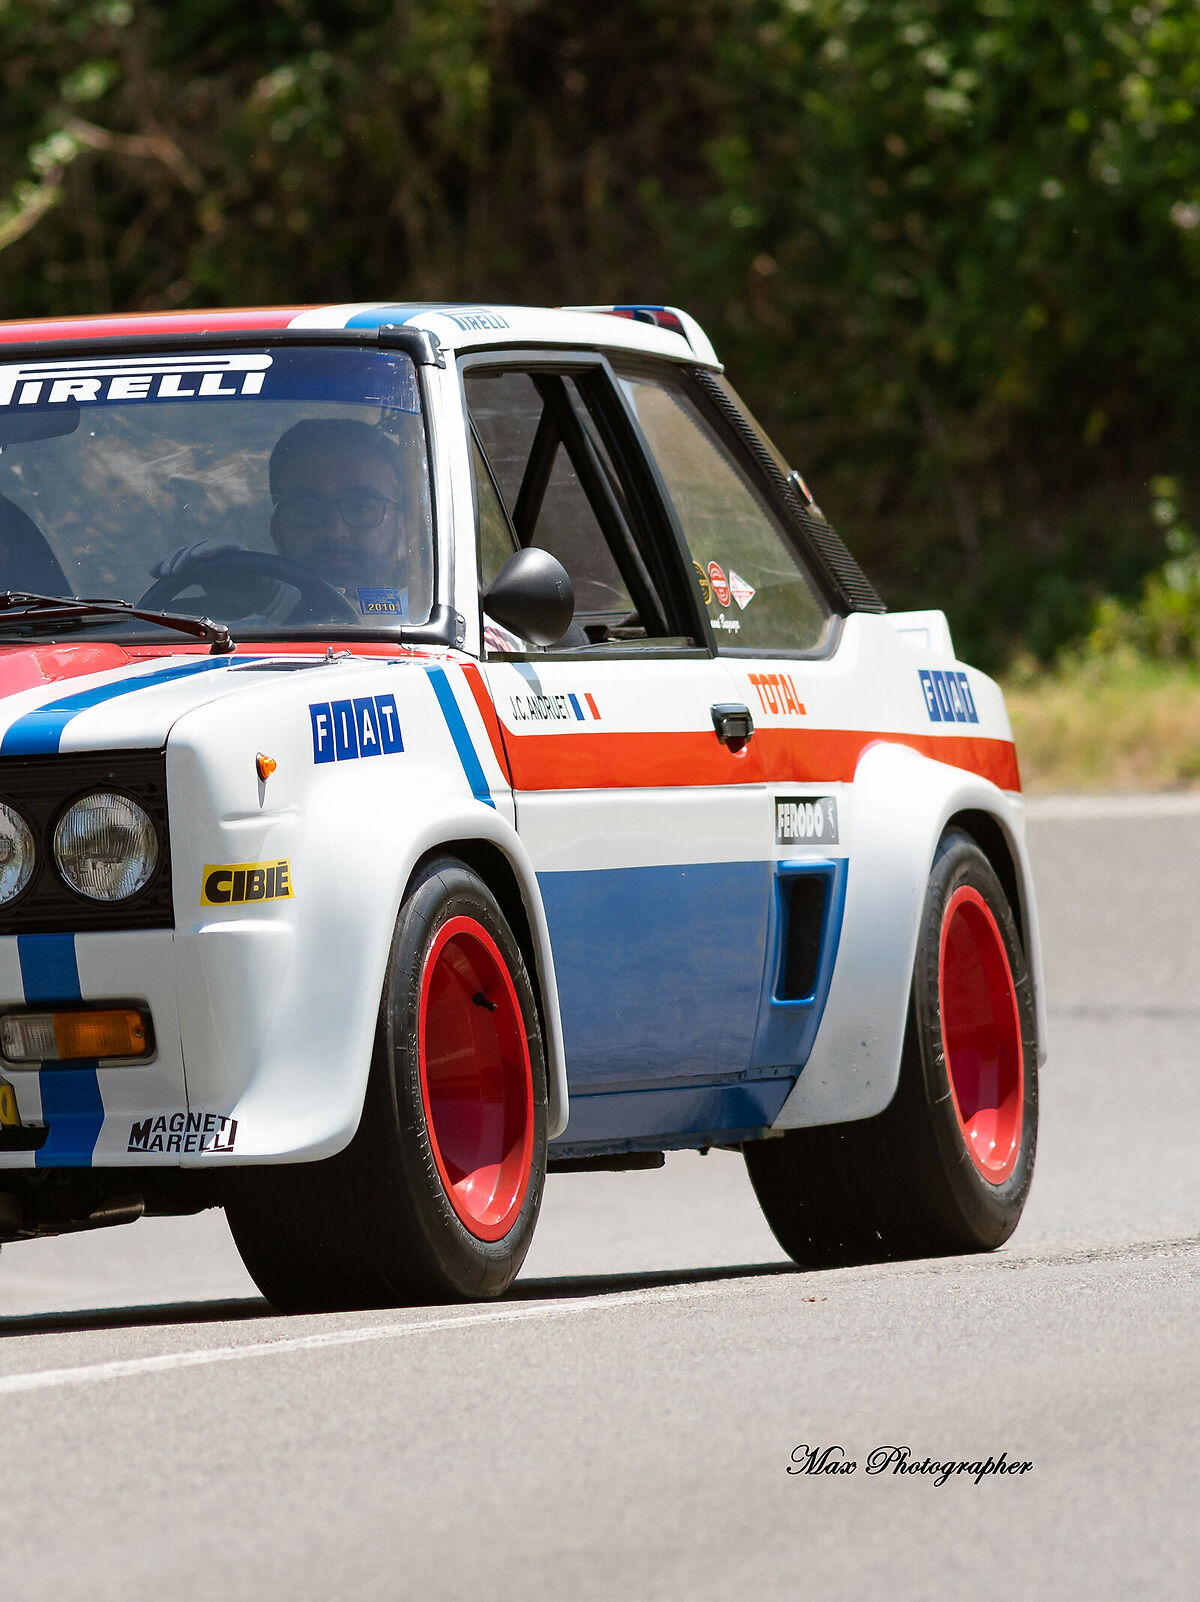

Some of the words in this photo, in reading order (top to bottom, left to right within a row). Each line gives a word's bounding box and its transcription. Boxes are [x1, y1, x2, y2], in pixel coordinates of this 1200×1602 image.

[435, 309, 510, 331] PIRELLI
[367, 603, 395, 612] 2010
[509, 695, 529, 721] J.C.
[529, 695, 572, 720] ANDRUET
[748, 673, 806, 715] TOTAL
[922, 676, 976, 717] FIAT
[313, 701, 400, 756] FIAT
[777, 803, 823, 837] FERODO
[127, 1128, 236, 1152] MARELLI
[129, 1112, 238, 1142] MAGNETI
